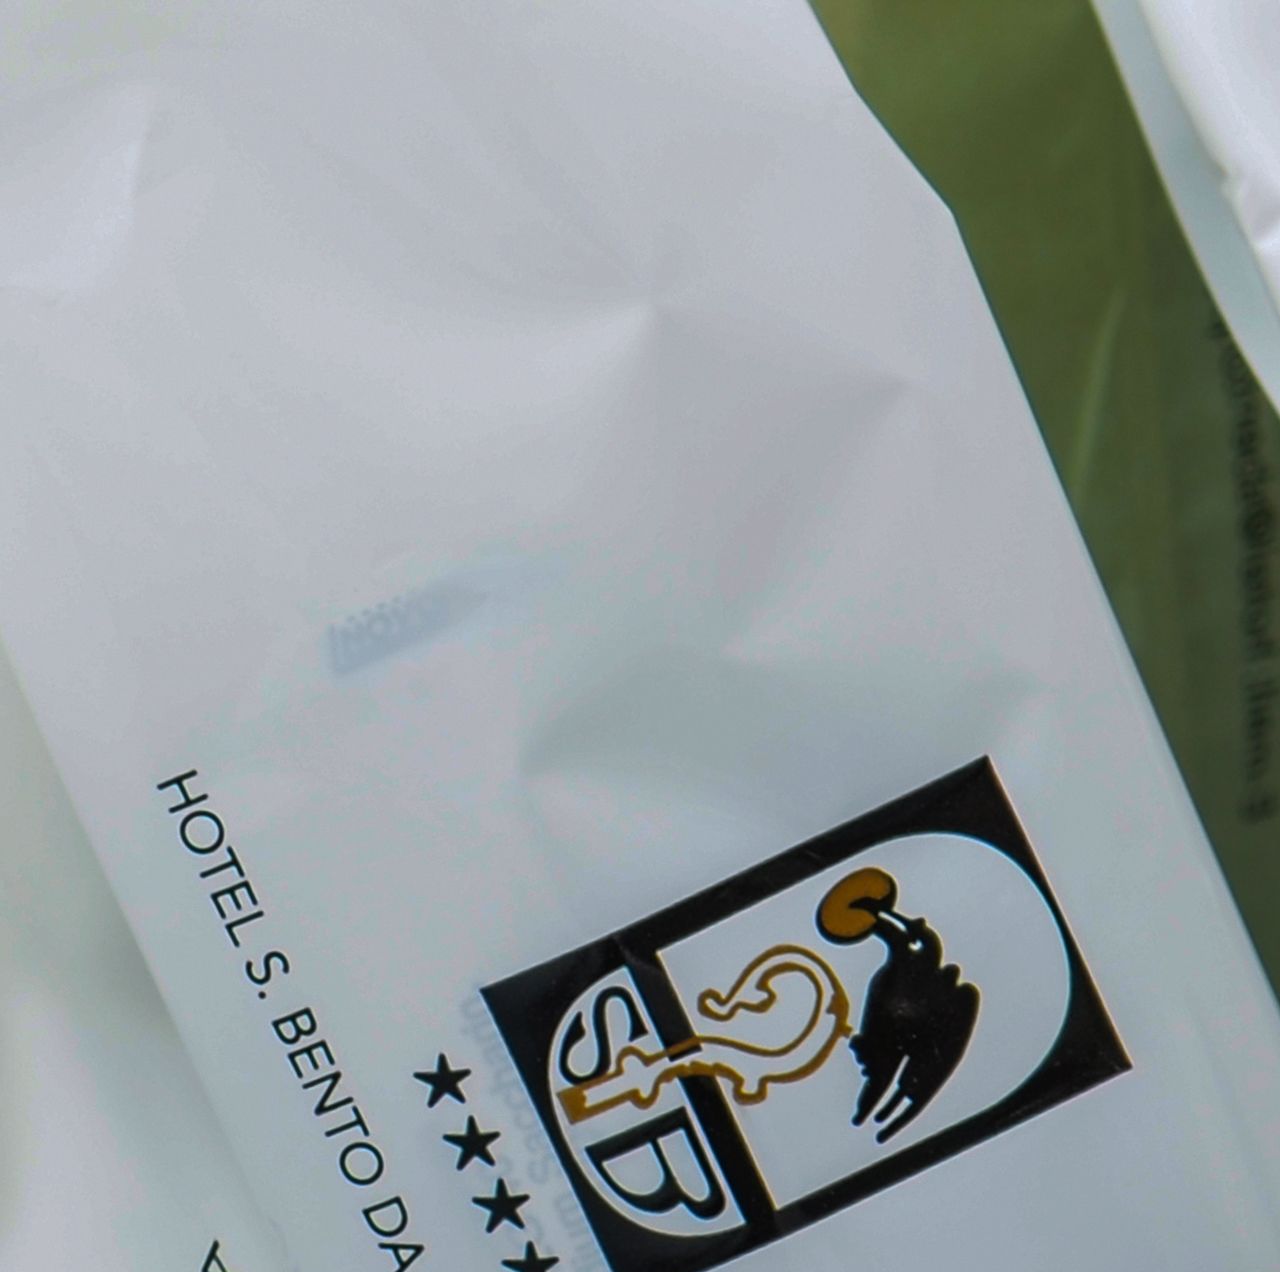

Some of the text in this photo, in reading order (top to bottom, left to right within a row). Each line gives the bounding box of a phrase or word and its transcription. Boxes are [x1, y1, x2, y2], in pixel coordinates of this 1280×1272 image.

[157, 770, 264, 948] HOTEL
[245, 951, 289, 999] S.
[271, 1007, 384, 1186] BENTO
